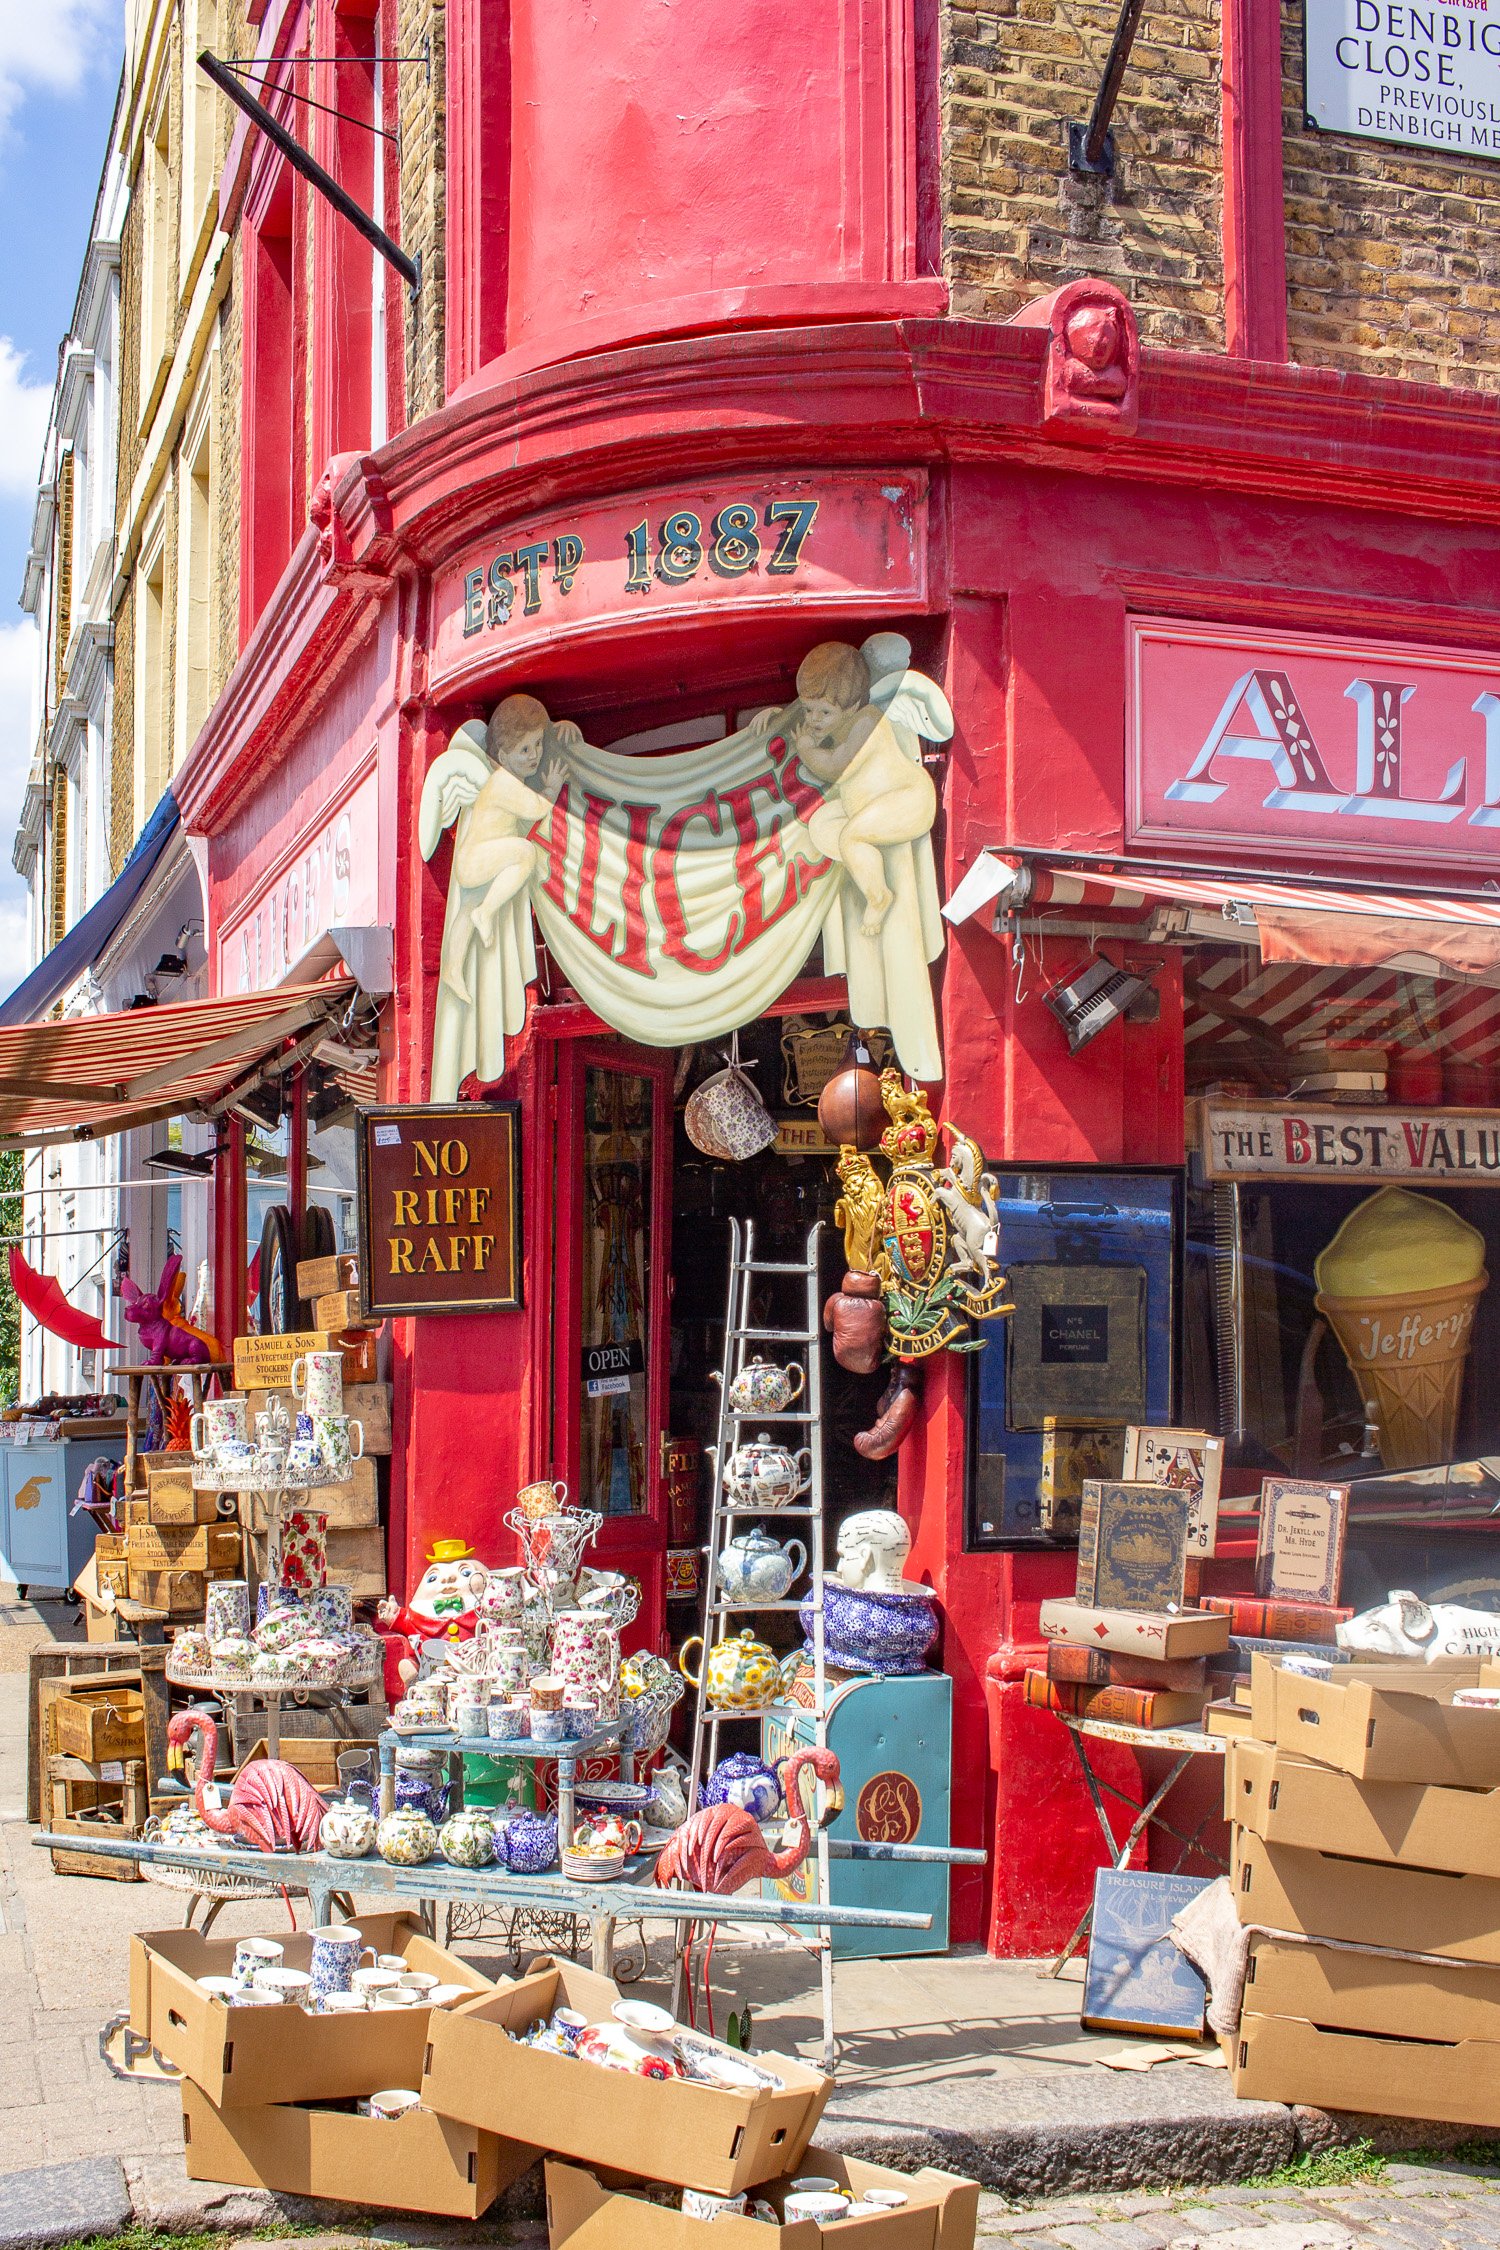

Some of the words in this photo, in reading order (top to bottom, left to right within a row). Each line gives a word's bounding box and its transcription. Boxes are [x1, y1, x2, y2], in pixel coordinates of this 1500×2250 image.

[1335, 36, 1463, 90] CLOSE,
[1358, 107, 1461, 142] DENBIGH
[625, 501, 820, 595] 1887
[780, 1128, 816, 1144] THE
[1218, 1131, 1273, 1157] THE
[1282, 1118, 1388, 1167] BEST
[411, 1139, 469, 1177] NO
[392, 1187, 490, 1226] RIFF
[387, 1235, 495, 1274] RAFF
[1049, 1329, 1101, 1339] CHANEL
[1360, 1304, 1475, 1361] Jeffery's
[254, 1339, 284, 1352] SAMUEL
[286, 1340, 292, 1349] &
[295, 1336, 316, 1348] SONS
[911, 1329, 943, 1354] MON
[255, 1354, 260, 1363] &
[261, 1352, 294, 1362] VEGETABLE
[589, 1347, 631, 1371] OPEN
[256, 1364, 289, 1373] STOCKERS
[262, 1375, 301, 1384] TENTERN
[602, 1381, 626, 1390] Facebook
[1290, 1526, 1311, 1535] JEKYLL
[1299, 1538, 1316, 1547] HYDE
[1043, 1622, 1058, 1635] K
[1147, 1625, 1163, 1640] K
[1107, 1876, 1165, 1890] TREASURE
[1170, 1883, 1206, 1894] ISLAN
